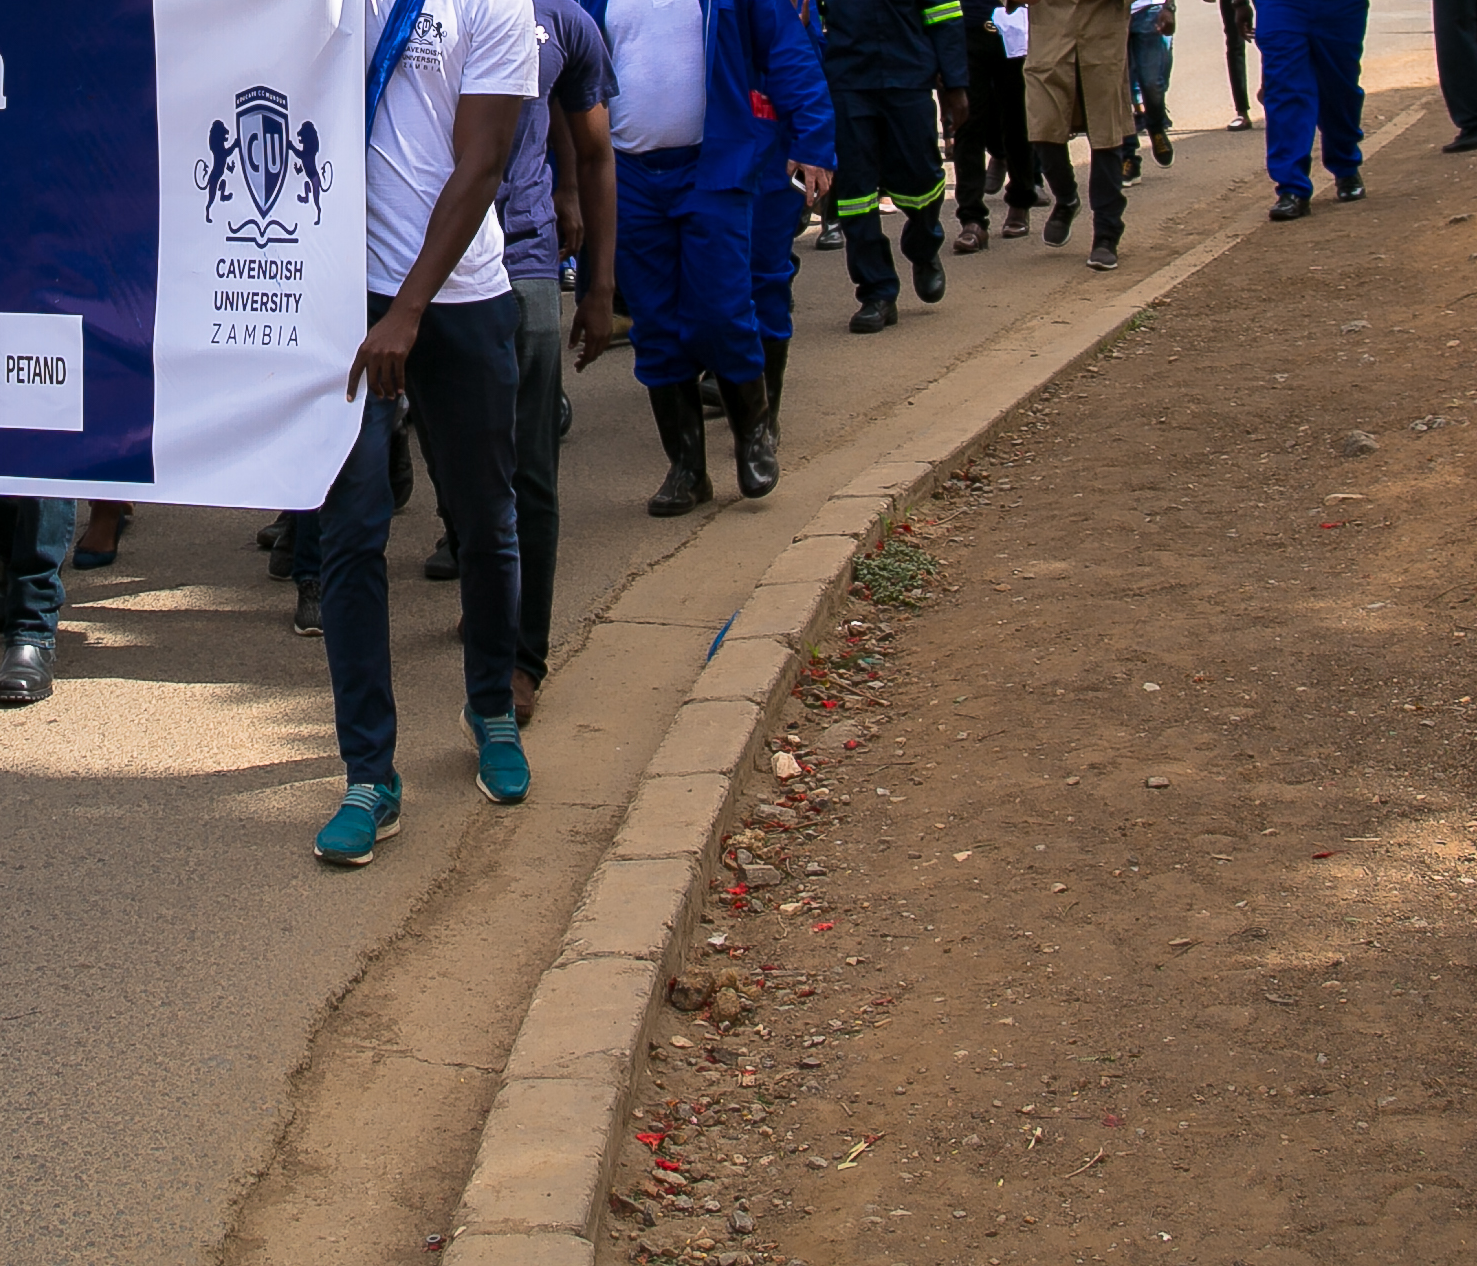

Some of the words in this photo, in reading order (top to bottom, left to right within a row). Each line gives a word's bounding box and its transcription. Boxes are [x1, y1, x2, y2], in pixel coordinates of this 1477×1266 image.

[405, 45, 443, 57] AVENDISH
[247, 132, 281, 174] CU
[215, 258, 304, 281] CAVENDISH
[213, 290, 303, 314] UNIVERSITY
[210, 323, 299, 347] ZAMBIA
[5, 354, 67, 386] PETAND
